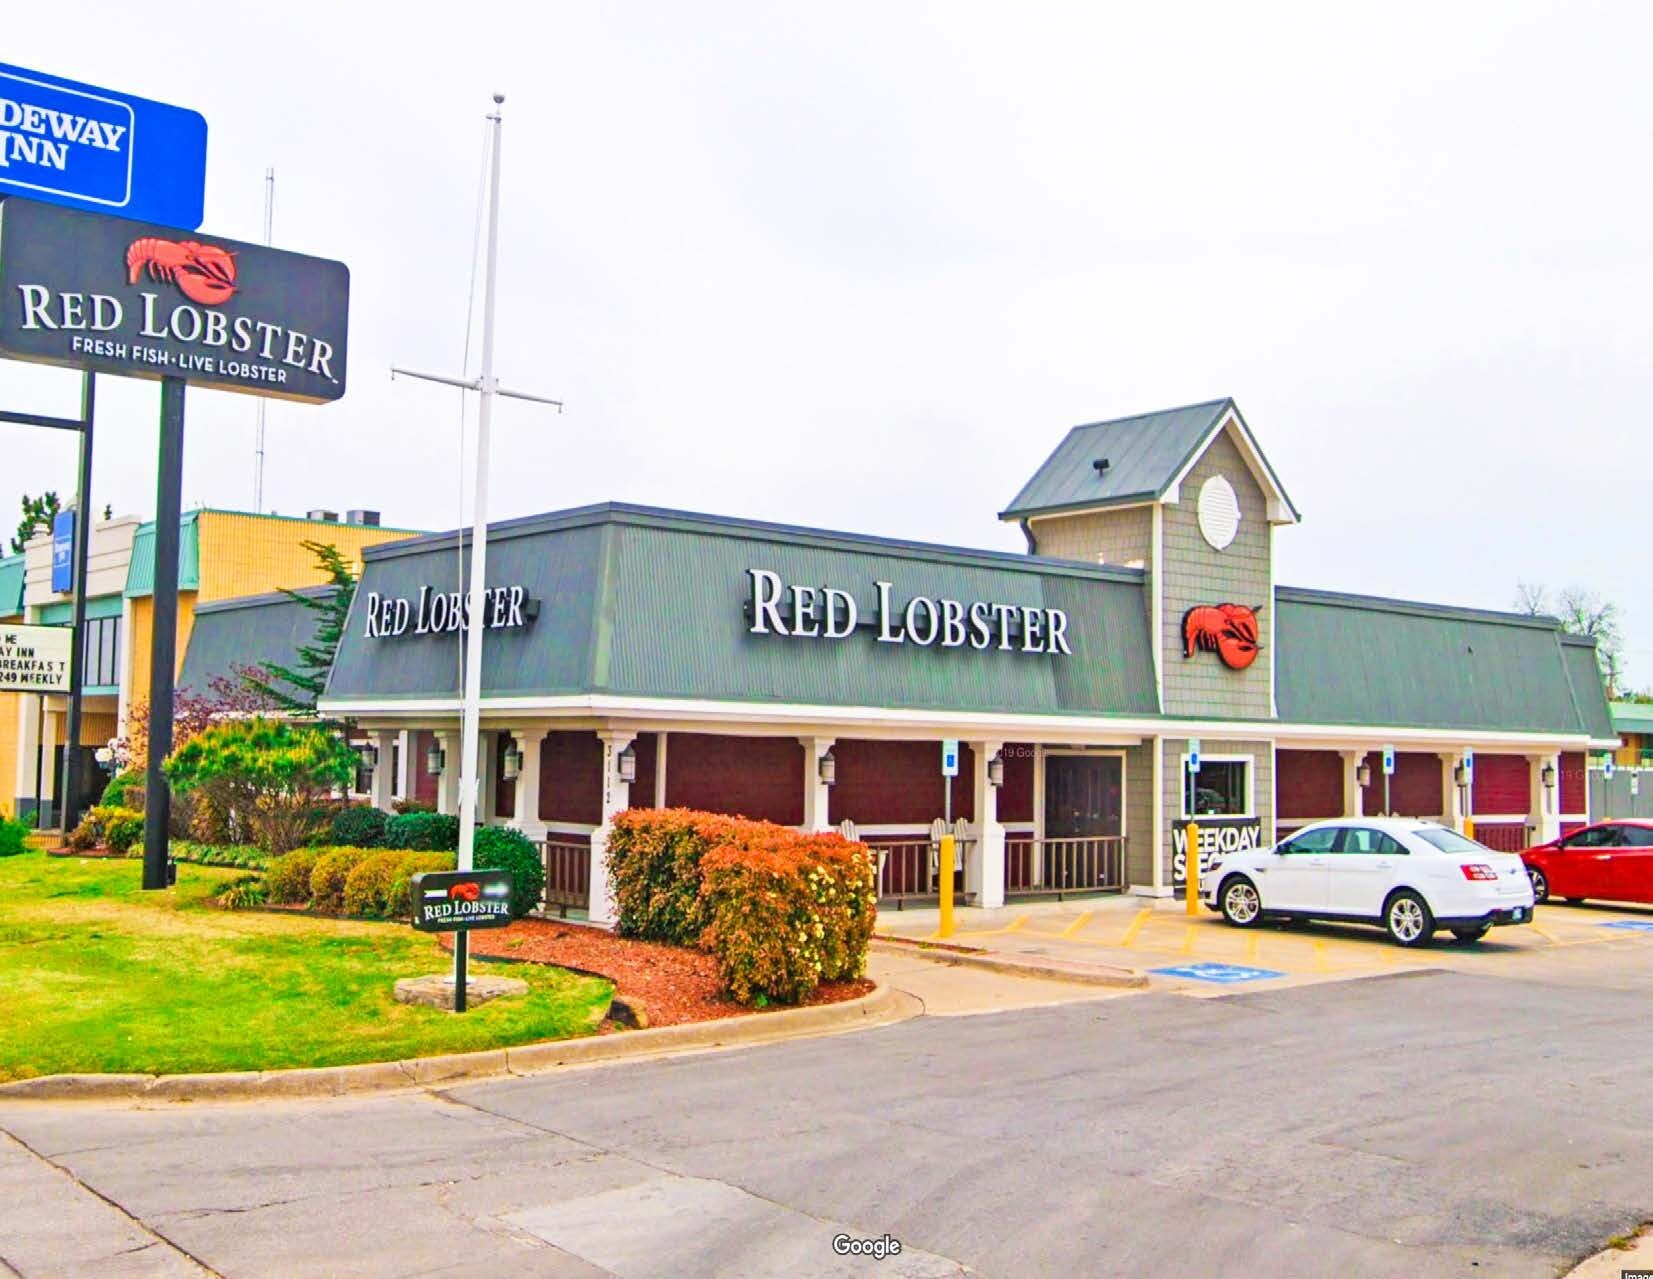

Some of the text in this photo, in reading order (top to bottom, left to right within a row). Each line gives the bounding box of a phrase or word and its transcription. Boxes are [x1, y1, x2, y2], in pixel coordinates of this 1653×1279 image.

[0, 130, 69, 170] INN
[19, 284, 333, 378] RED LOBSTER
[72, 336, 127, 359] FRESH
[219, 360, 287, 383] LOBSTER
[364, 592, 409, 638] RED
[750, 568, 1072, 655] RED LOBSTER
[16, 647, 35, 658] INN
[20, 673, 62, 685] WEEKLY
[424, 904, 452, 921] RED
[454, 900, 509, 915] LOBSTER
